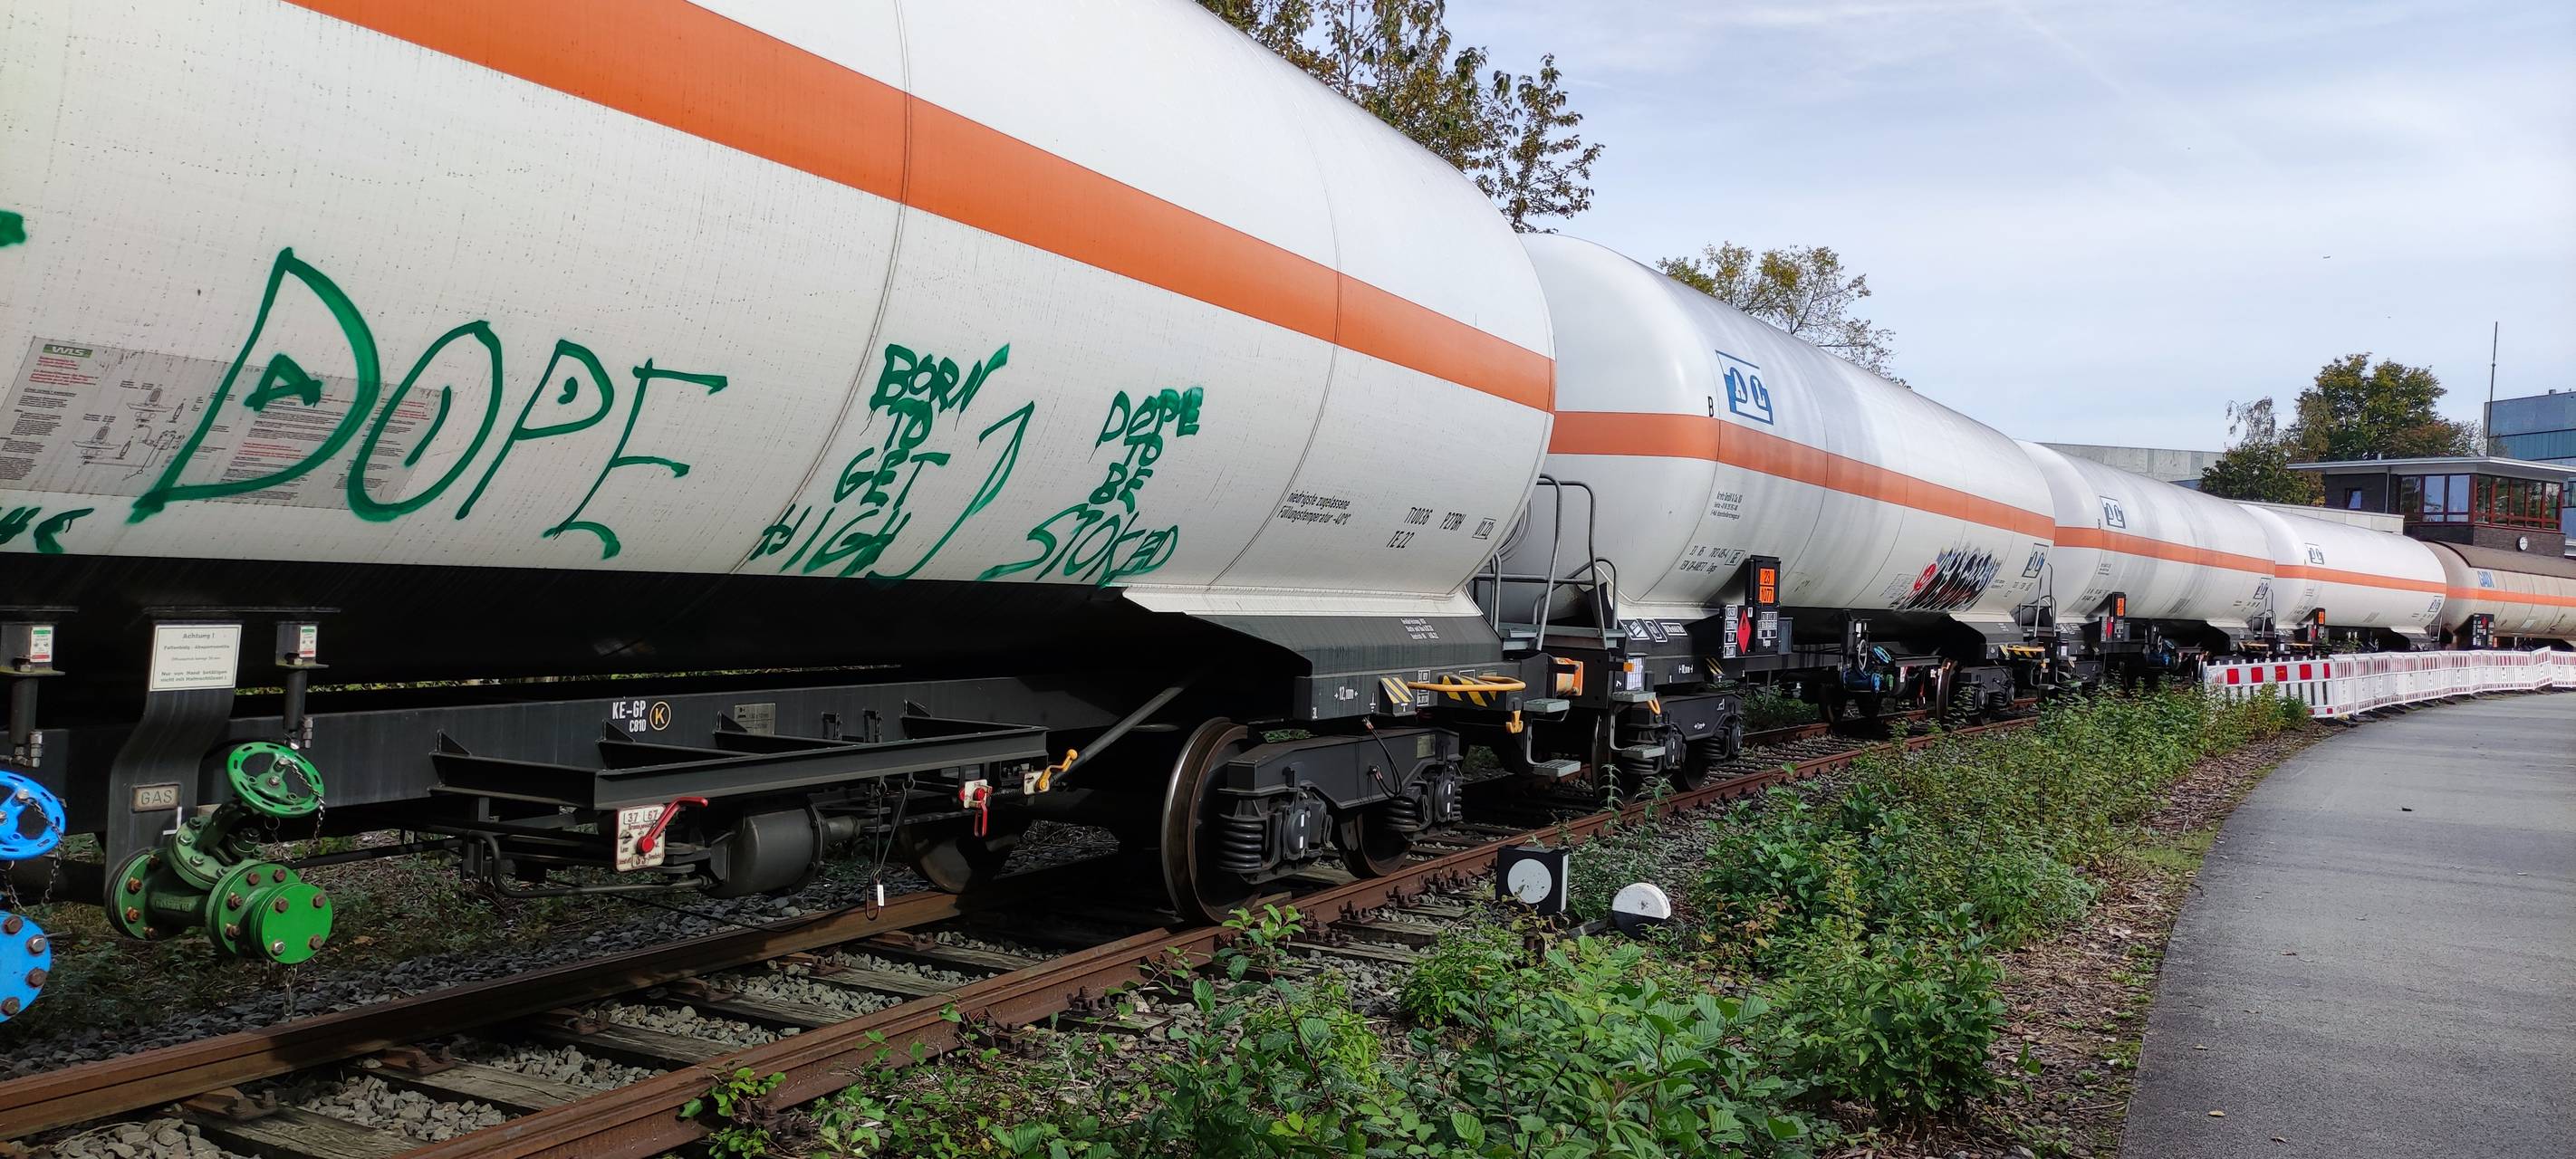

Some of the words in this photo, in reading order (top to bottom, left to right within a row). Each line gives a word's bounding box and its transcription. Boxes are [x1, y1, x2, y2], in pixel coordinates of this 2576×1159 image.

[870, 343, 1010, 413] BORN
[125, 246, 726, 560] DOPE
[1093, 388, 1204, 447] DOPE
[1707, 396, 1715, 417] B
[881, 398, 934, 455] TO
[1123, 435, 1164, 466] TO
[833, 448, 950, 510] GET
[1089, 463, 1153, 512] BE
[977, 503, 1177, 584] STOKED
[1396, 532, 1415, 549] 22
[612, 700, 647, 720] KE-GP
[654, 707, 666, 725] K
[140, 789, 173, 805] GAS
[628, 812, 639, 822] 37
[647, 809, 658, 820] 67
